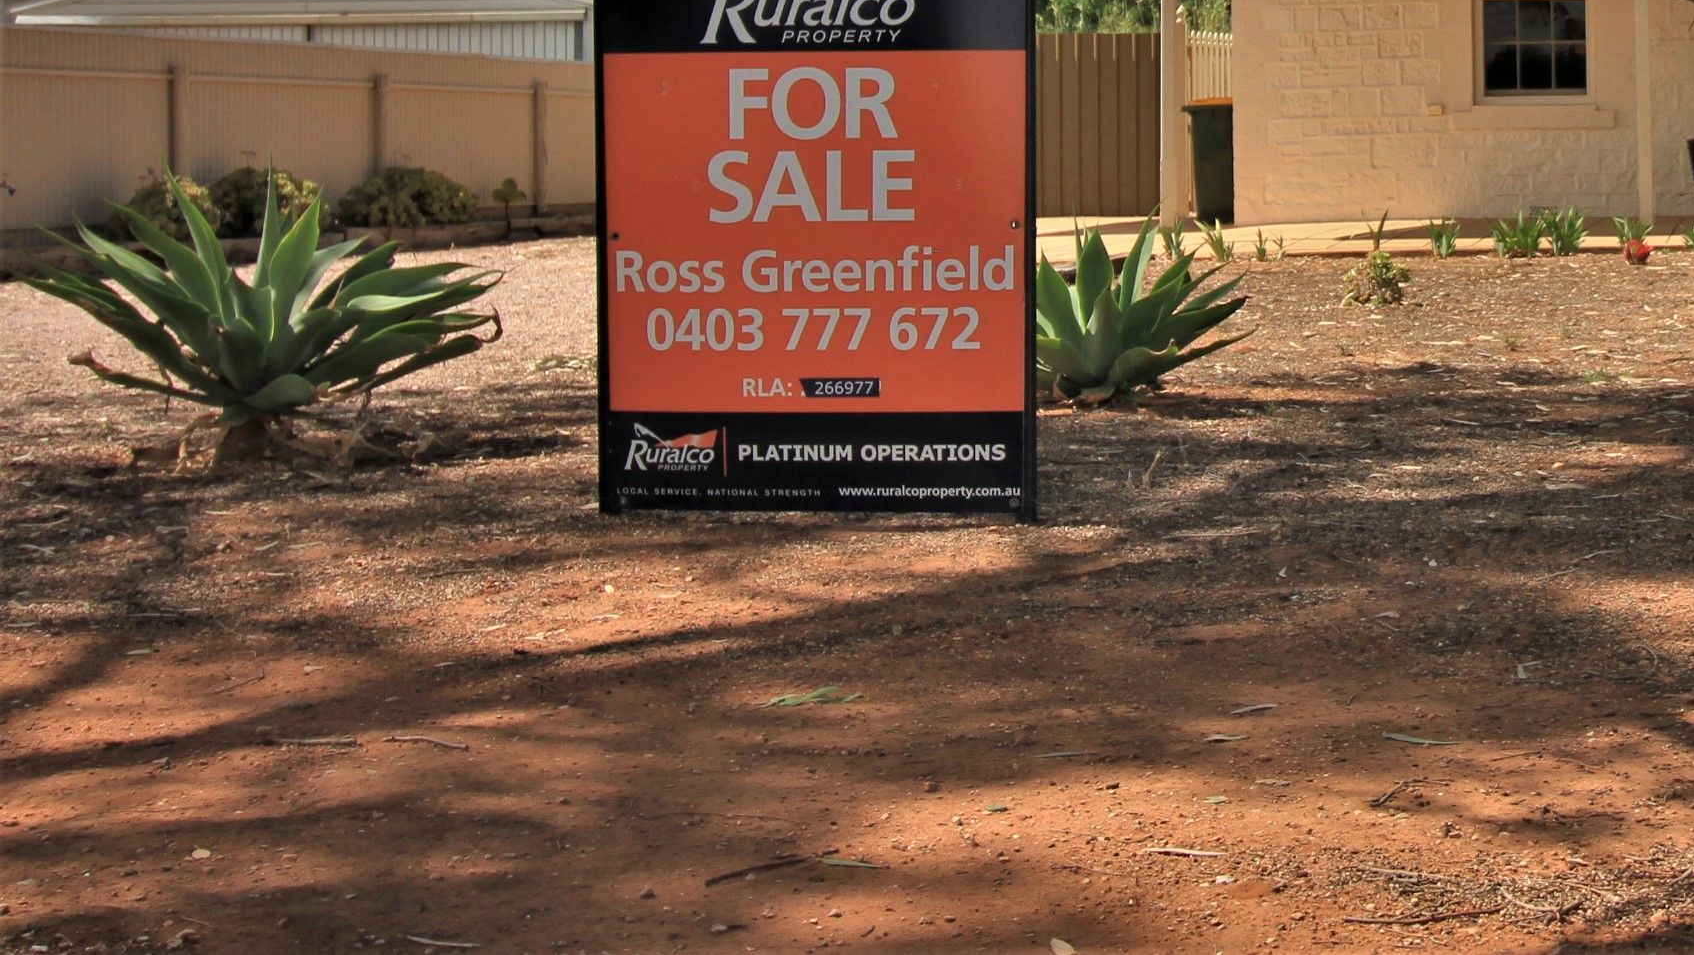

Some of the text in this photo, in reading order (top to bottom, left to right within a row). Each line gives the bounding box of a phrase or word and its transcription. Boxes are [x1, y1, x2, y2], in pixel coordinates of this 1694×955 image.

[781, 29, 903, 44] PROPERTY
[728, 66, 899, 141] FOR
[707, 148, 915, 224] SALE
[615, 244, 1015, 294] Ross Greenfield
[646, 306, 981, 352] 0403 777 672
[742, 378, 874, 397] RLA: 266977
[624, 438, 715, 471] Ruralco
[738, 443, 1007, 462] PLATINUM OPERATIONS
[657, 463, 709, 472] PROPERTY
[616, 487, 649, 495] LOCAL
[707, 488, 758, 496] NATIONAL
[764, 488, 821, 497] STRENGTH
[838, 485, 1021, 499] www.ruralcoproperty.com.au
